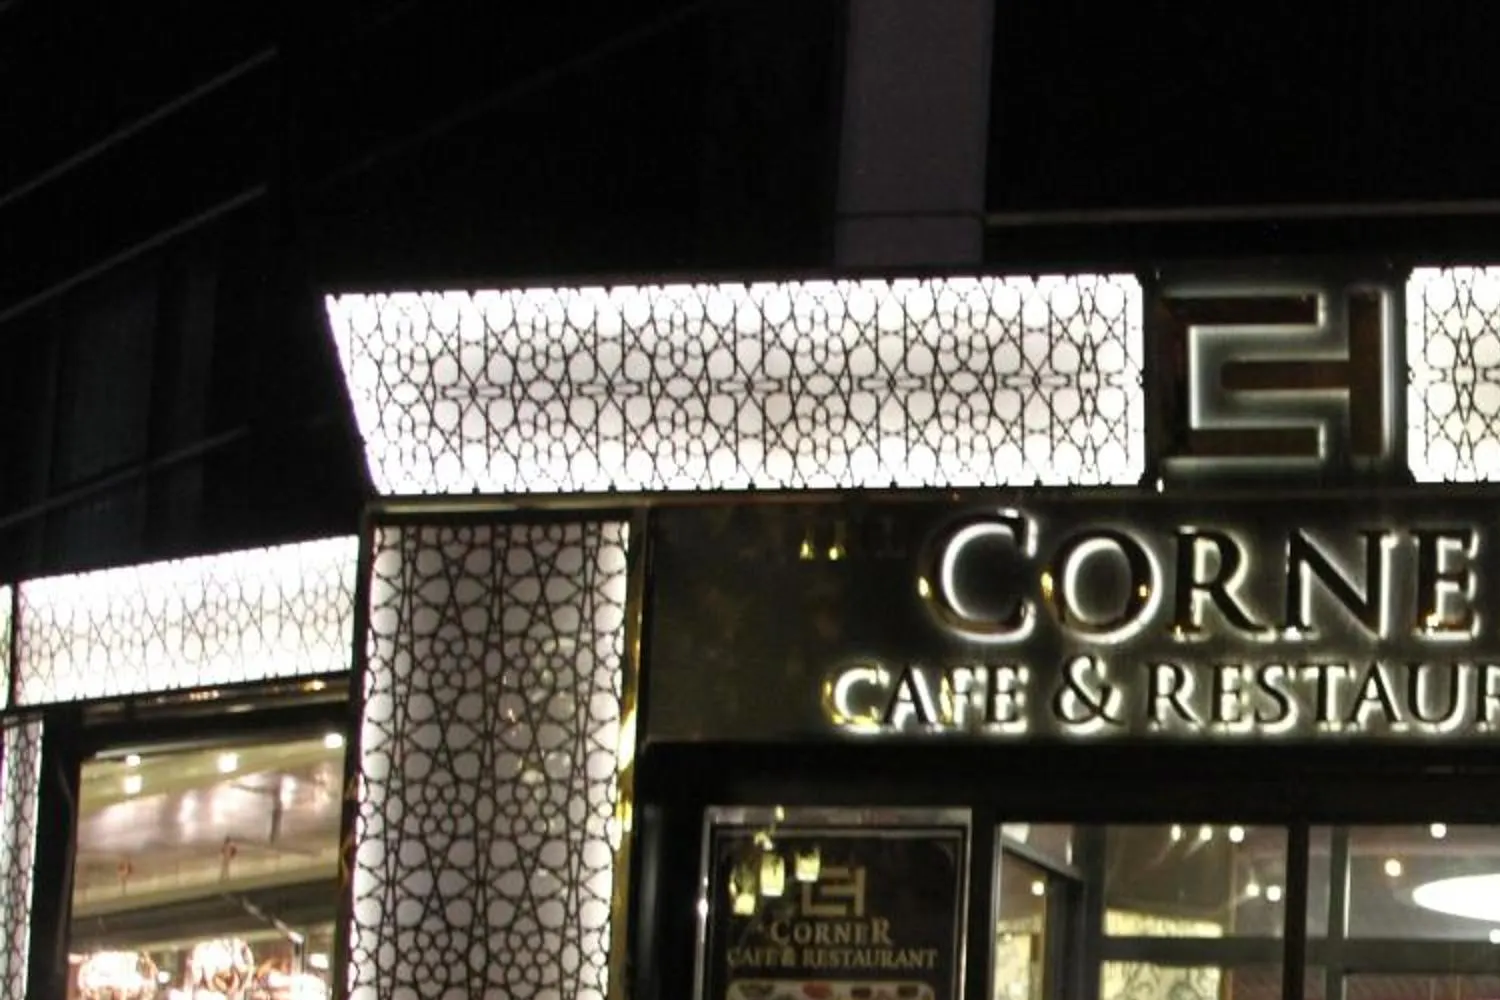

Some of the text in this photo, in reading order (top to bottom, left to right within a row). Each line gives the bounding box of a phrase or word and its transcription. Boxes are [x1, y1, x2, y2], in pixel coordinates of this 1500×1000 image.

[826, 658, 1029, 735] CAFE
[1051, 654, 1126, 736] &
[770, 917, 893, 945] CORNER
[727, 948, 780, 967] CAFE
[802, 948, 938, 969] RESTAURANT
